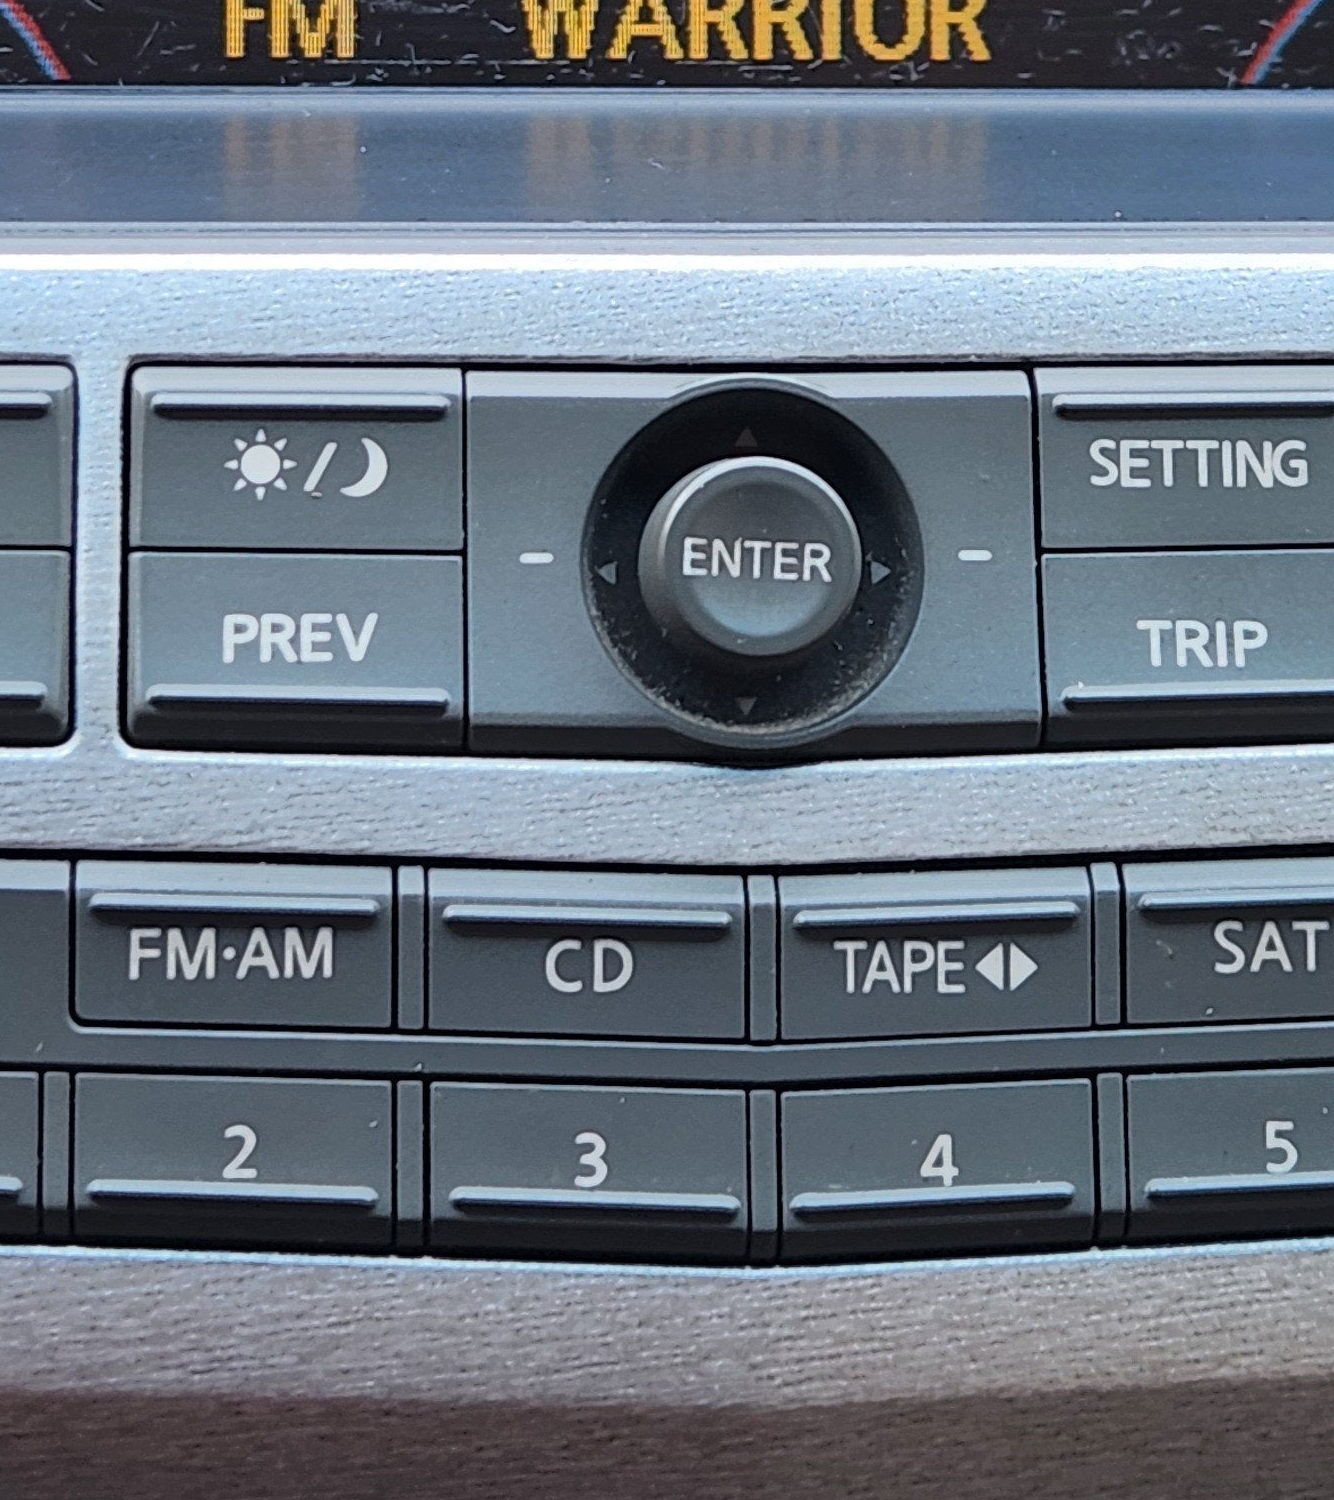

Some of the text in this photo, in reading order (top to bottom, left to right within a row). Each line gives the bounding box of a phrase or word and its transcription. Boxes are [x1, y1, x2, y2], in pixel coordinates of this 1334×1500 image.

[1089, 438, 1309, 490] SETTING
[682, 537, 832, 584] ENTER
[222, 613, 378, 663] PREV
[1136, 618, 1269, 668] TRIP
[544, 938, 635, 996] CD
[833, 940, 967, 995] TAPE
[1213, 921, 1331, 975] SAT
[221, 1126, 261, 1181] 2
[573, 1132, 610, 1188] 3
[918, 1135, 960, 1187] 4
[1263, 1121, 1298, 1173] 5
